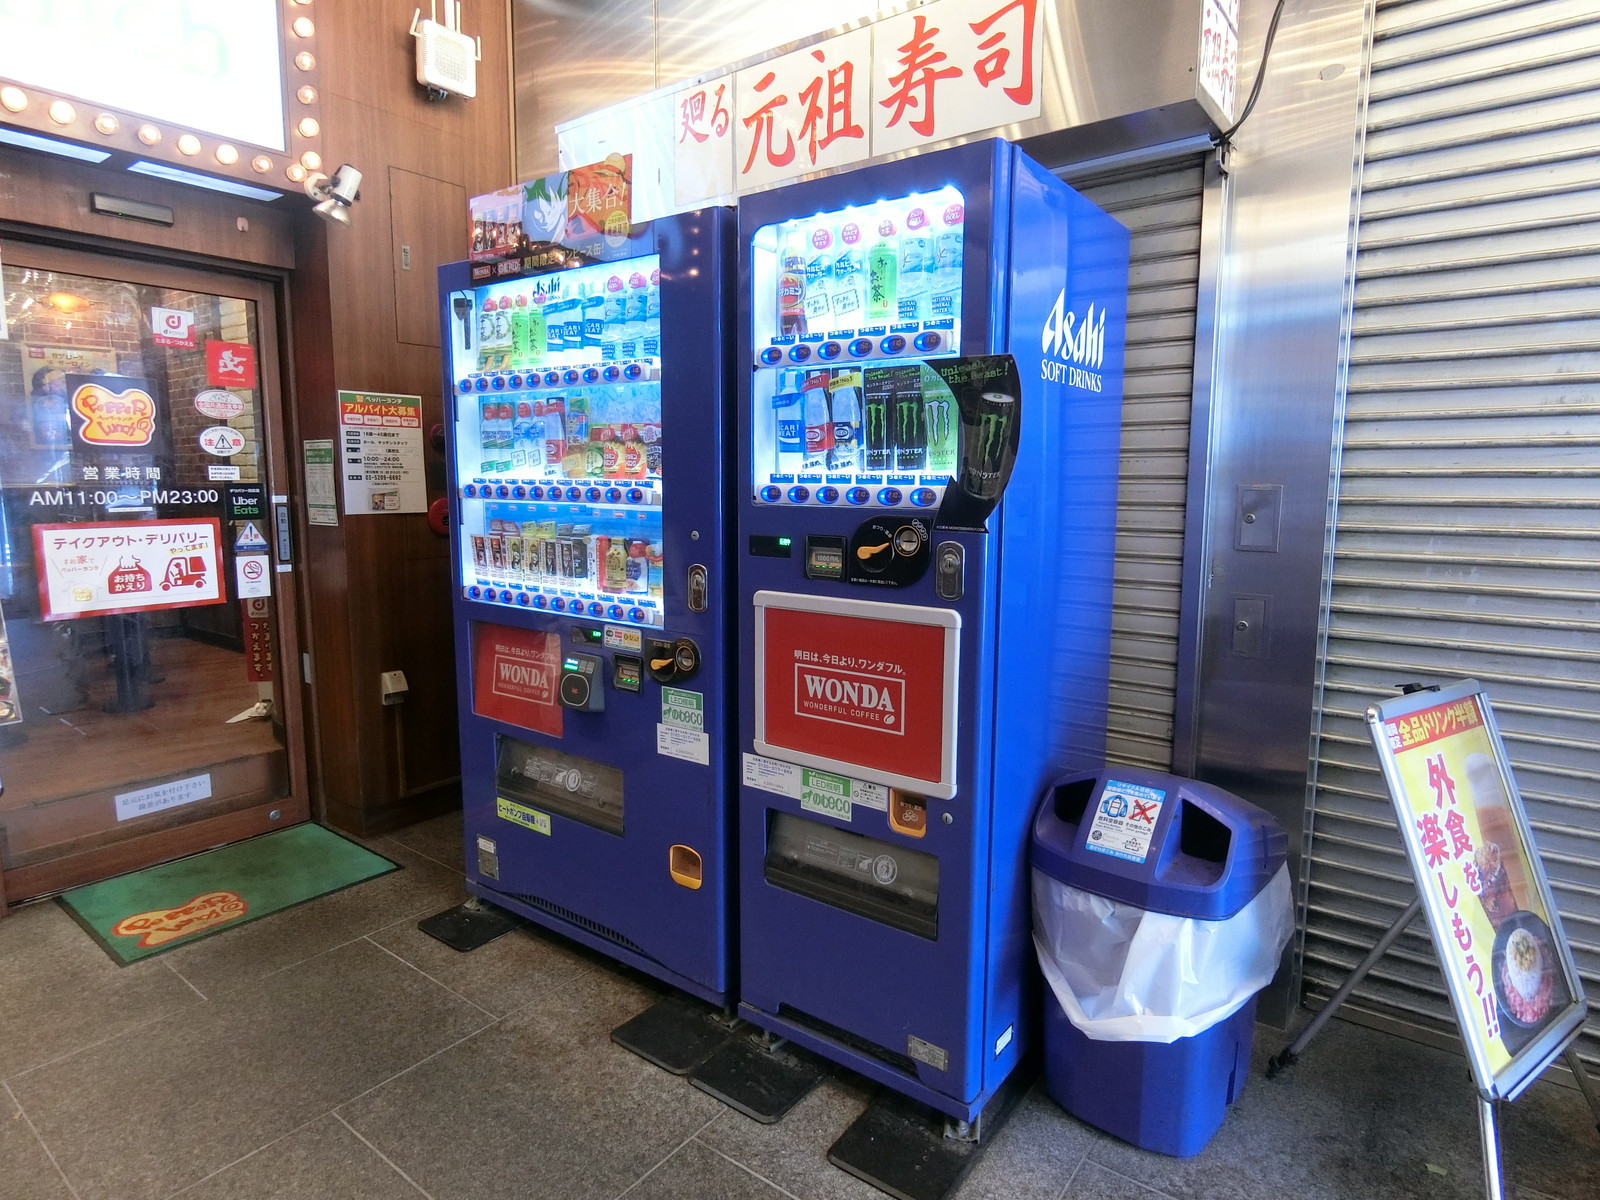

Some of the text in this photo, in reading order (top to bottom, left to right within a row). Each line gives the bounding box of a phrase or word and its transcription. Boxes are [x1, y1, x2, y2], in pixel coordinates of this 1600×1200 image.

[679, 83, 729, 145] 廻る
[568, 182, 627, 218] 大集合!
[1042, 287, 1106, 370] Asahi
[940, 360, 985, 377] Unleash
[948, 374, 968, 384] the
[1041, 358, 1102, 393] SOFT DRINKS
[344, 403, 416, 417] アルバイト大募集
[82, 465, 161, 480] 営業時間
[232, 496, 258, 505] Uber
[233, 506, 259, 515] Eats
[114, 573, 145, 583] お持ち
[114, 583, 145, 591] かえり
[794, 649, 907, 676] 明日は、今日より、ワンダフル。
[499, 662, 549, 689] WONDA
[497, 682, 523, 693] WONDERFUL
[803, 674, 895, 712] WONDA
[803, 700, 880, 721] WONDERFUL COFFEE
[1398, 700, 1478, 746] 全品ドリンク半額
[1426, 753, 1481, 892] 外食を
